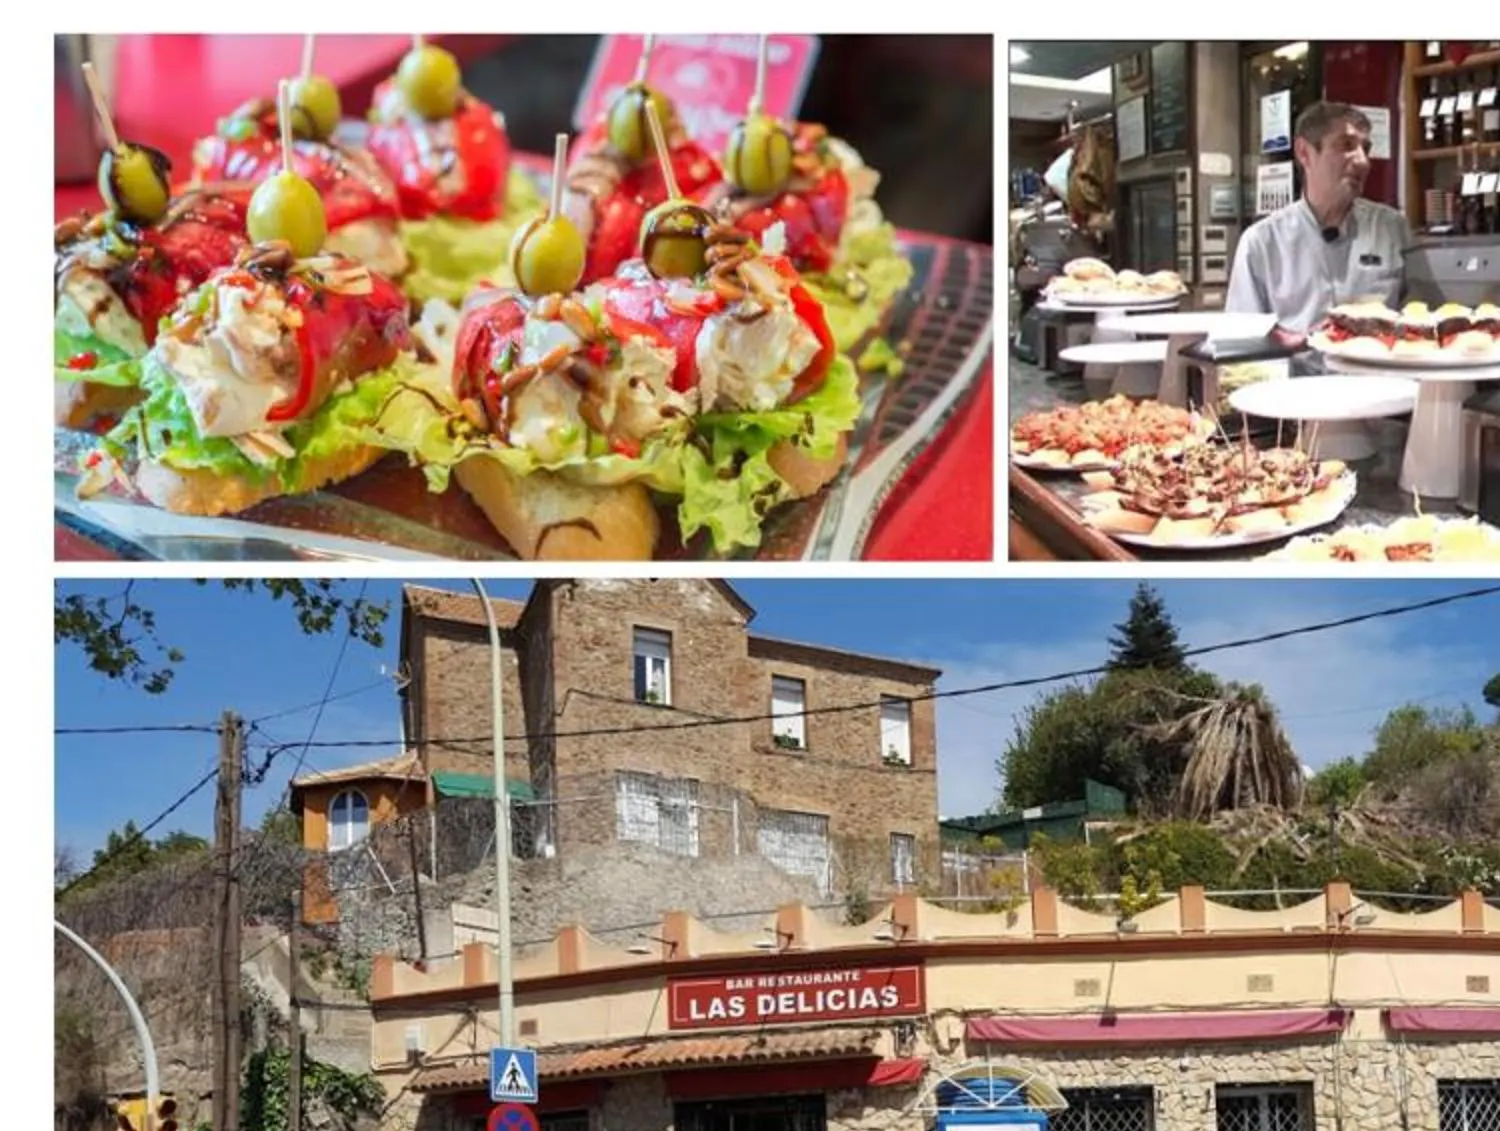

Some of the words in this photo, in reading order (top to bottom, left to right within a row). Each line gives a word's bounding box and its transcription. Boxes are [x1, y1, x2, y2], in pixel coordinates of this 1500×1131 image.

[725, 977, 755, 990] BAR
[757, 969, 861, 988] RESTAURANTE
[689, 995, 746, 1020] LAS
[756, 985, 900, 1015] DELICIAS
